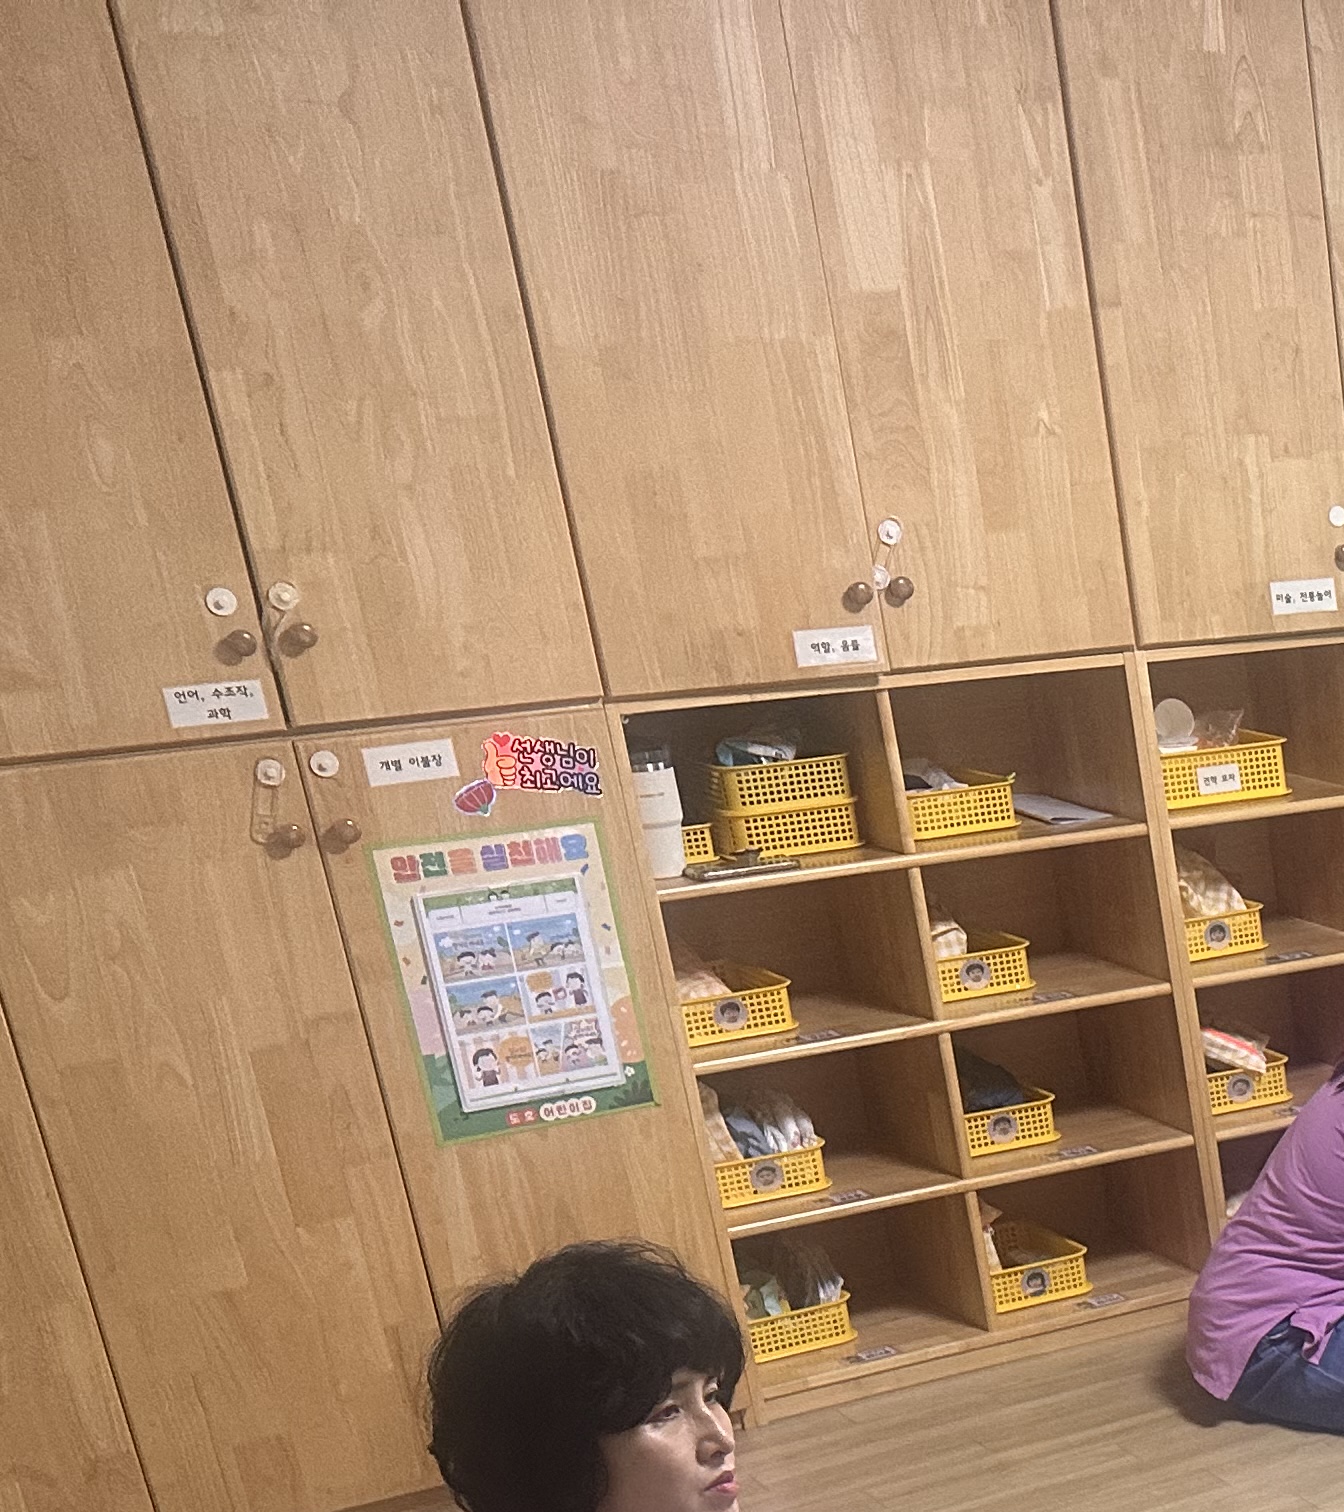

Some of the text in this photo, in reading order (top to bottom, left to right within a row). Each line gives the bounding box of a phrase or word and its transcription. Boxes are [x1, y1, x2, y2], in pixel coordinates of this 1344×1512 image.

[1299, 589, 1332, 602] 전통놀이
[173, 685, 254, 704] 언어, 수조작,
[207, 707, 232, 720] 과학
[511, 737, 598, 769] 선생님이
[379, 754, 442, 772] 개별 이불장
[519, 768, 603, 796] 최고에요
[390, 833, 590, 884] 안전을 실천해요
[543, 1099, 593, 1117] 어린이집
